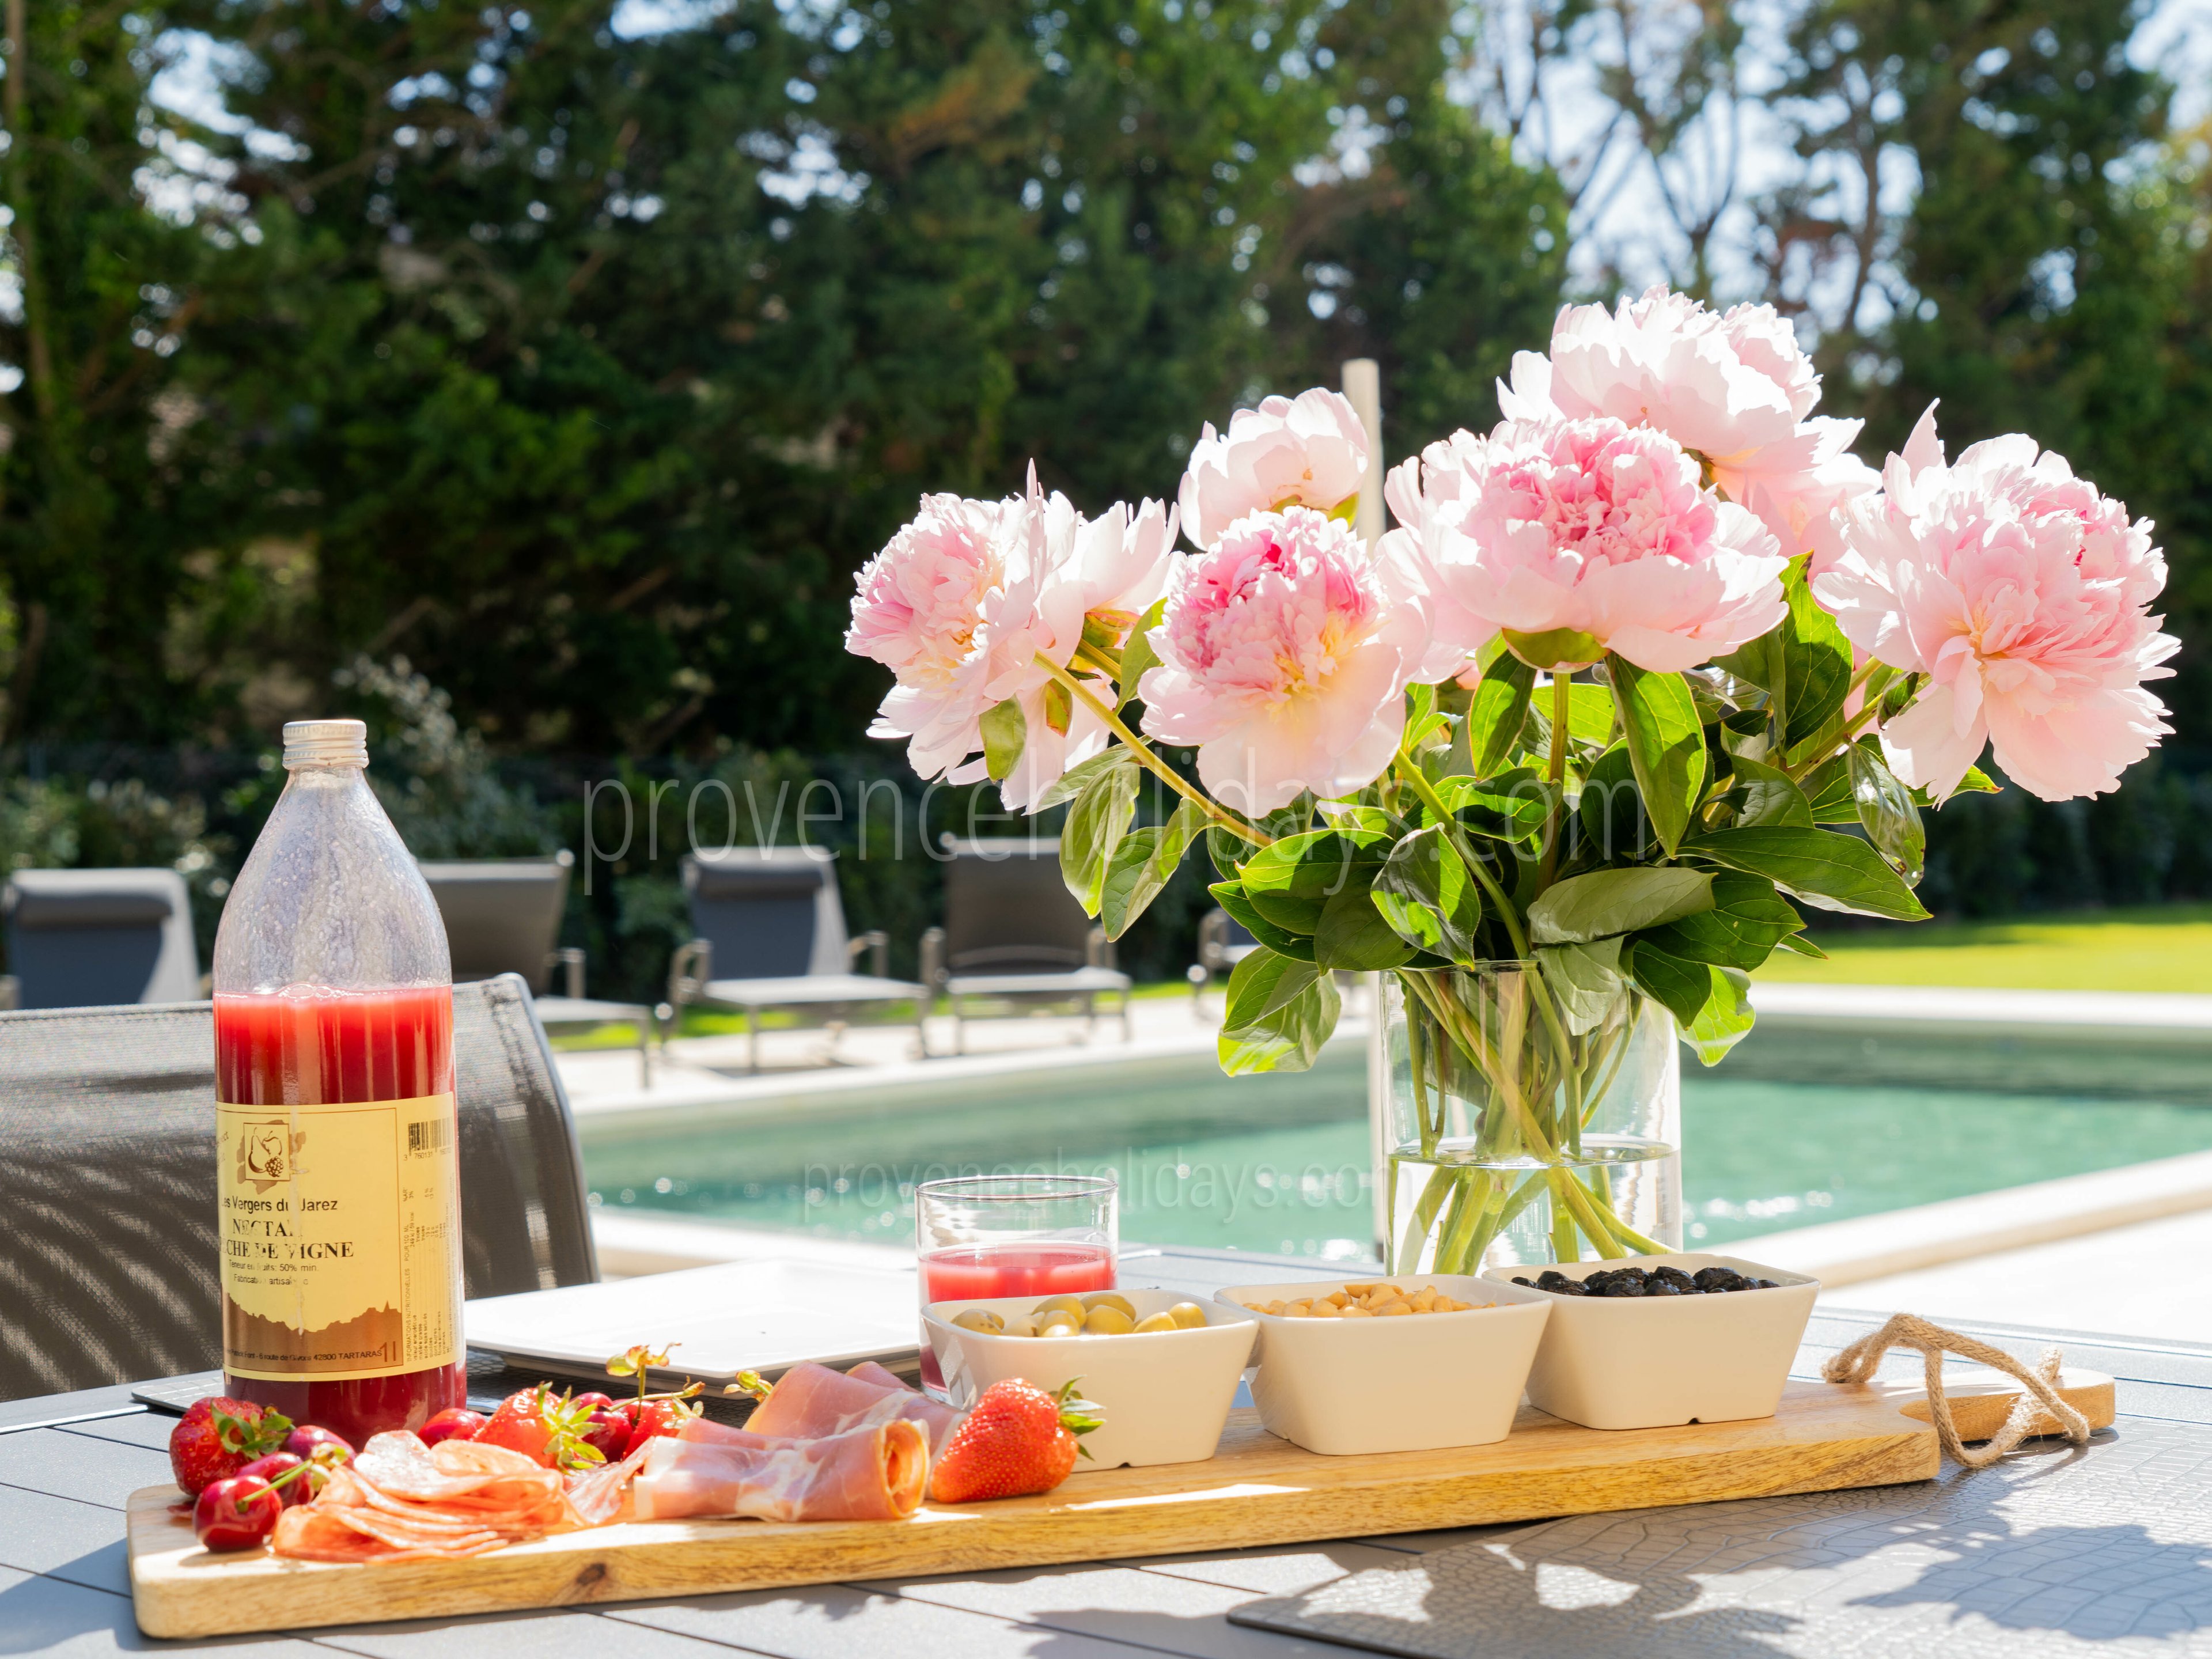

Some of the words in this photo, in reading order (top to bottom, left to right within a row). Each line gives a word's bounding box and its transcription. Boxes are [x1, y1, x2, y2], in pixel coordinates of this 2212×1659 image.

[232, 1195, 272, 1214] Vergers
[301, 1197, 338, 1212] Jarez
[232, 1218, 302, 1237] NECTA
[279, 1263, 297, 1272] 50%
[338, 1350, 382, 1359] TARTARAS
